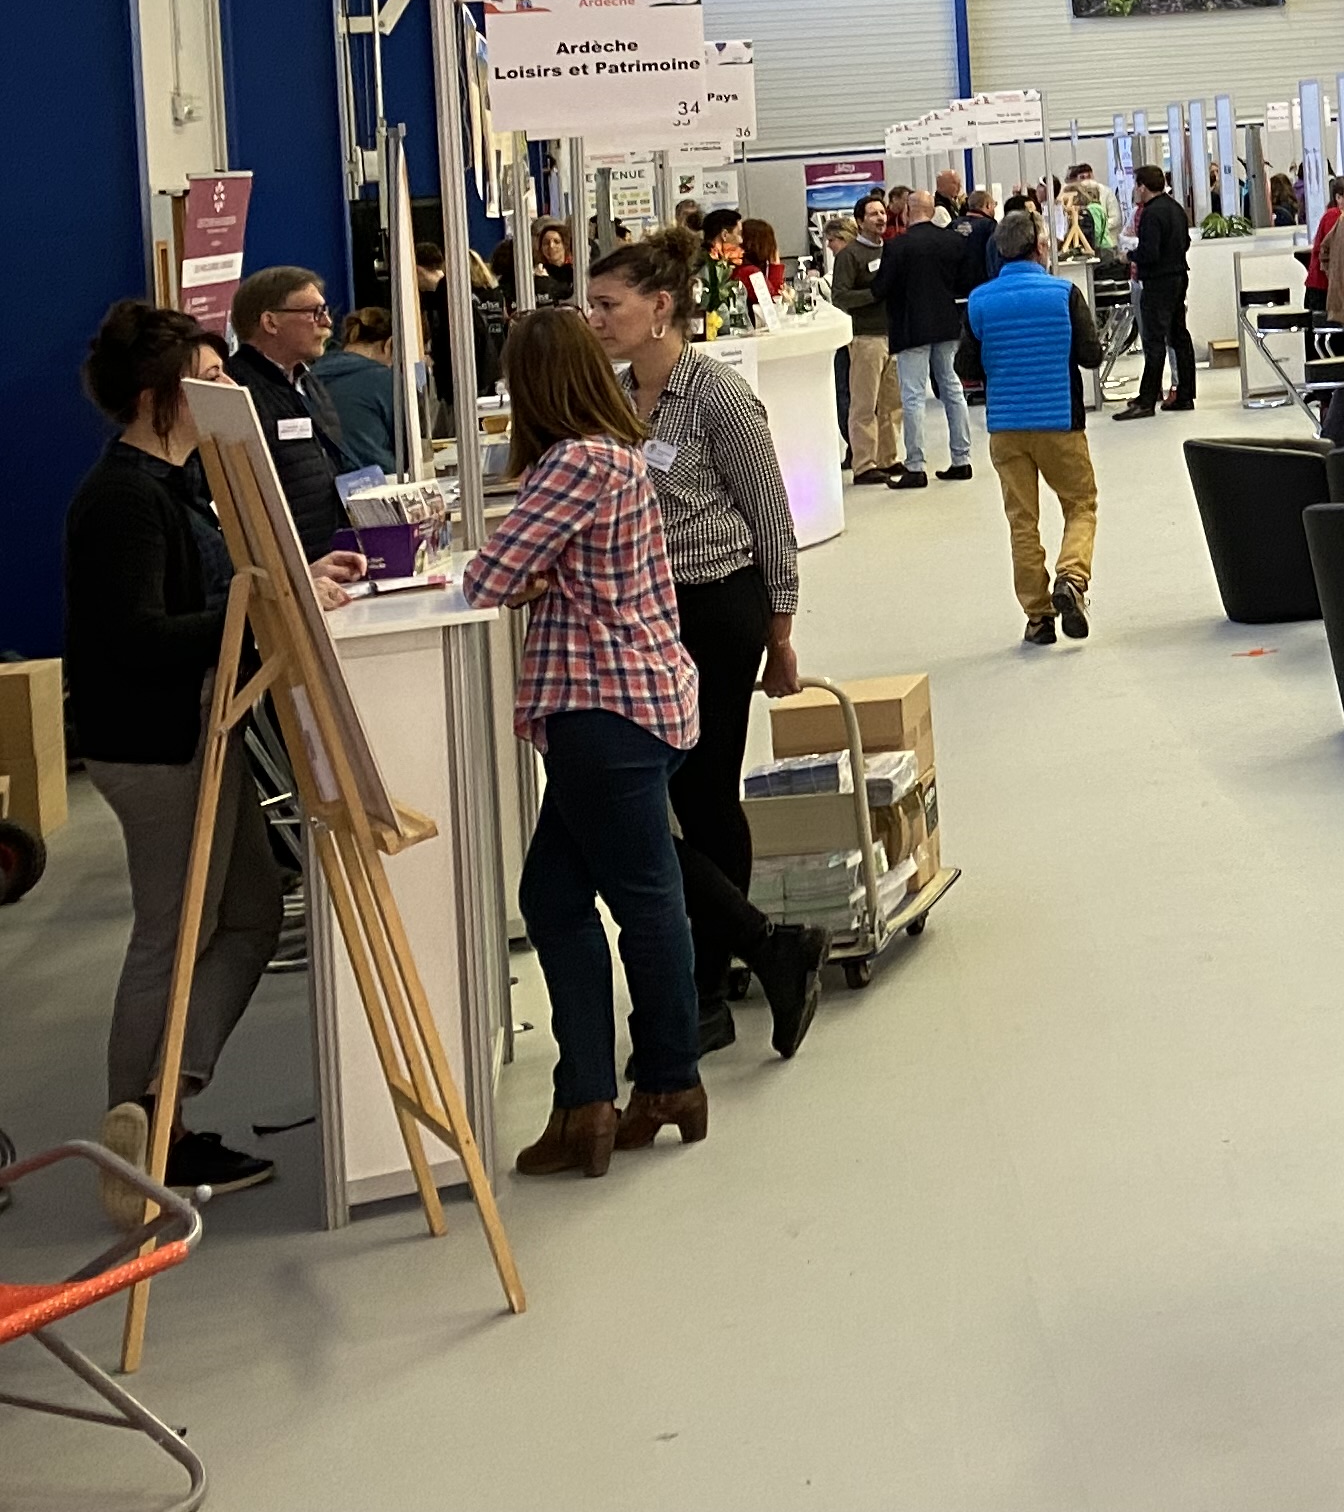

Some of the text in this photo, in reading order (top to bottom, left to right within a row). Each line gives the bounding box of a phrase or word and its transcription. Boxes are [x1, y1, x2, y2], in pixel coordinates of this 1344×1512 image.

[556, 40, 639, 56] Ardèche
[494, 57, 701, 80] Loisirs et Patrimoine
[707, 91, 739, 103] Pays
[678, 101, 701, 116] 34
[736, 126, 751, 137] 36
